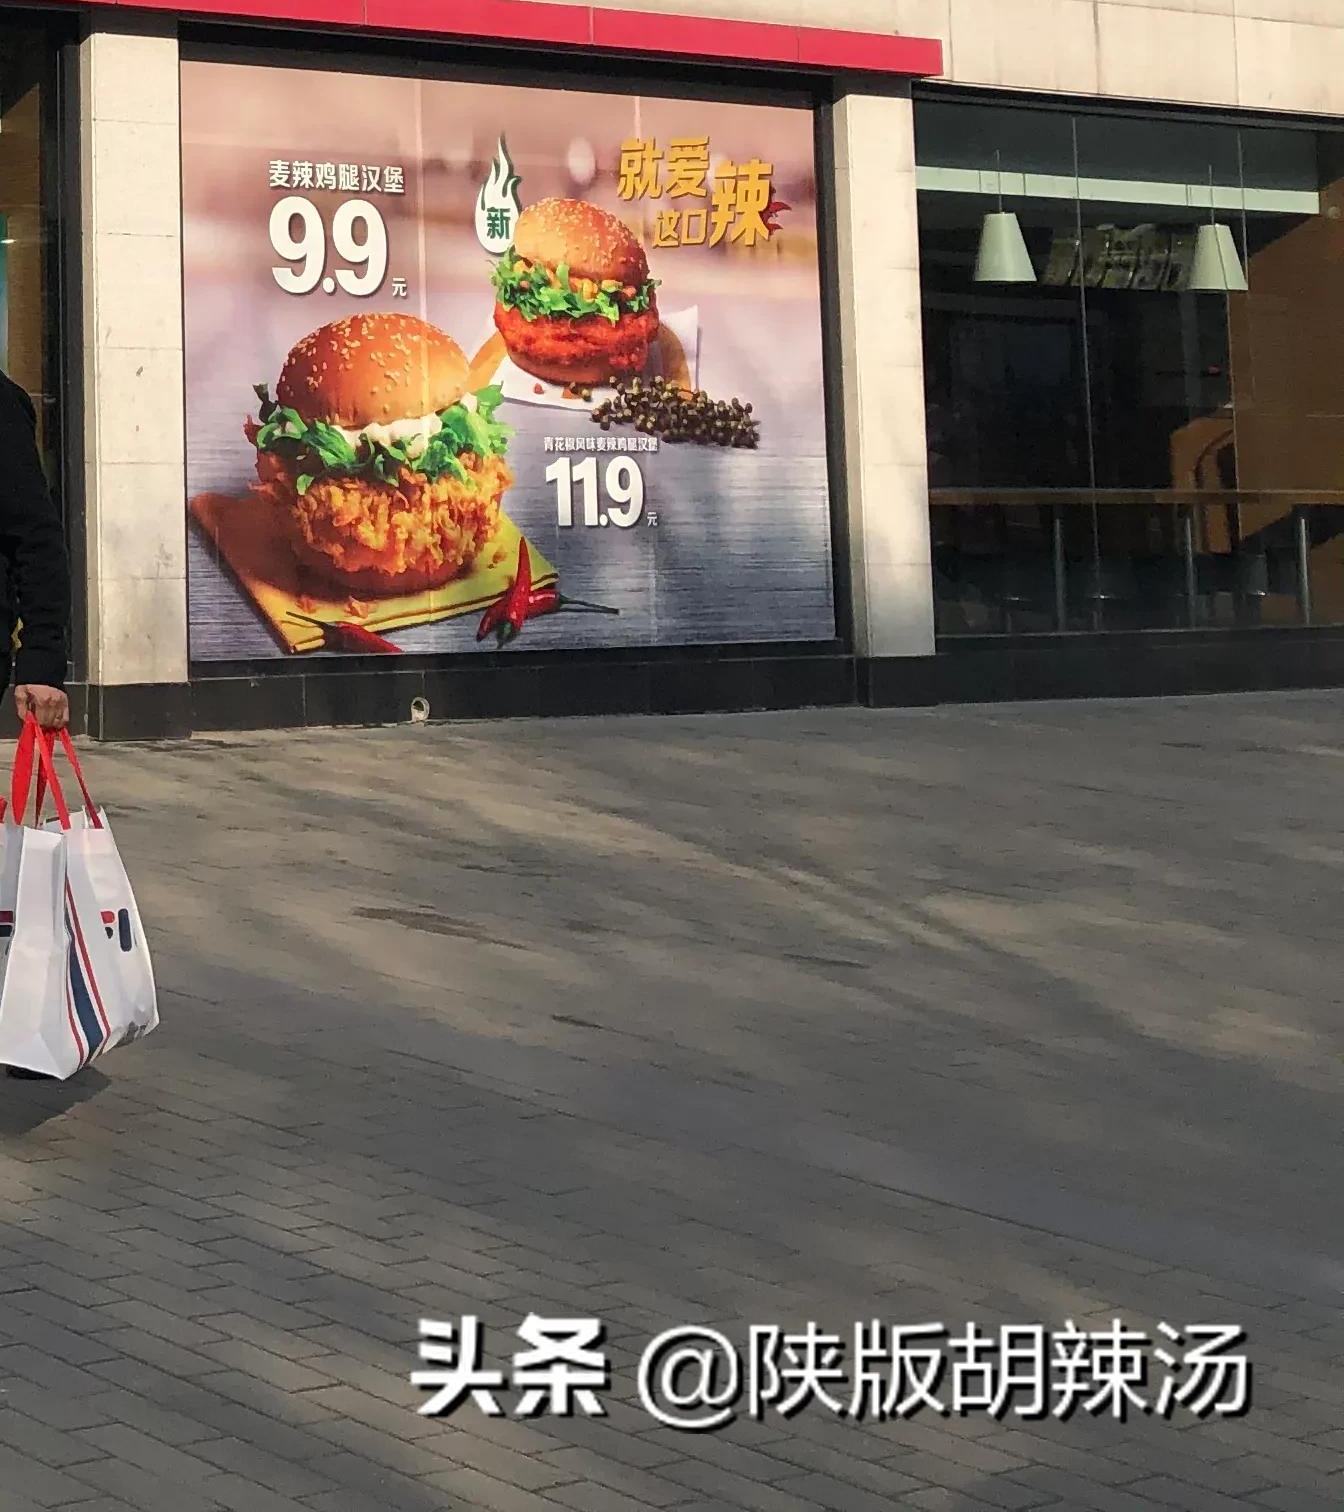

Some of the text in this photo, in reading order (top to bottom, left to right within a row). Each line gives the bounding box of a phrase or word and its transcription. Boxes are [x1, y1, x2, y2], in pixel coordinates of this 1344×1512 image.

[268, 160, 405, 194] 麦辣鸡腿汉堡
[616, 135, 710, 201] 就爱
[486, 206, 512, 240] 新
[709, 158, 774, 248] 辣
[652, 208, 708, 249] 这口
